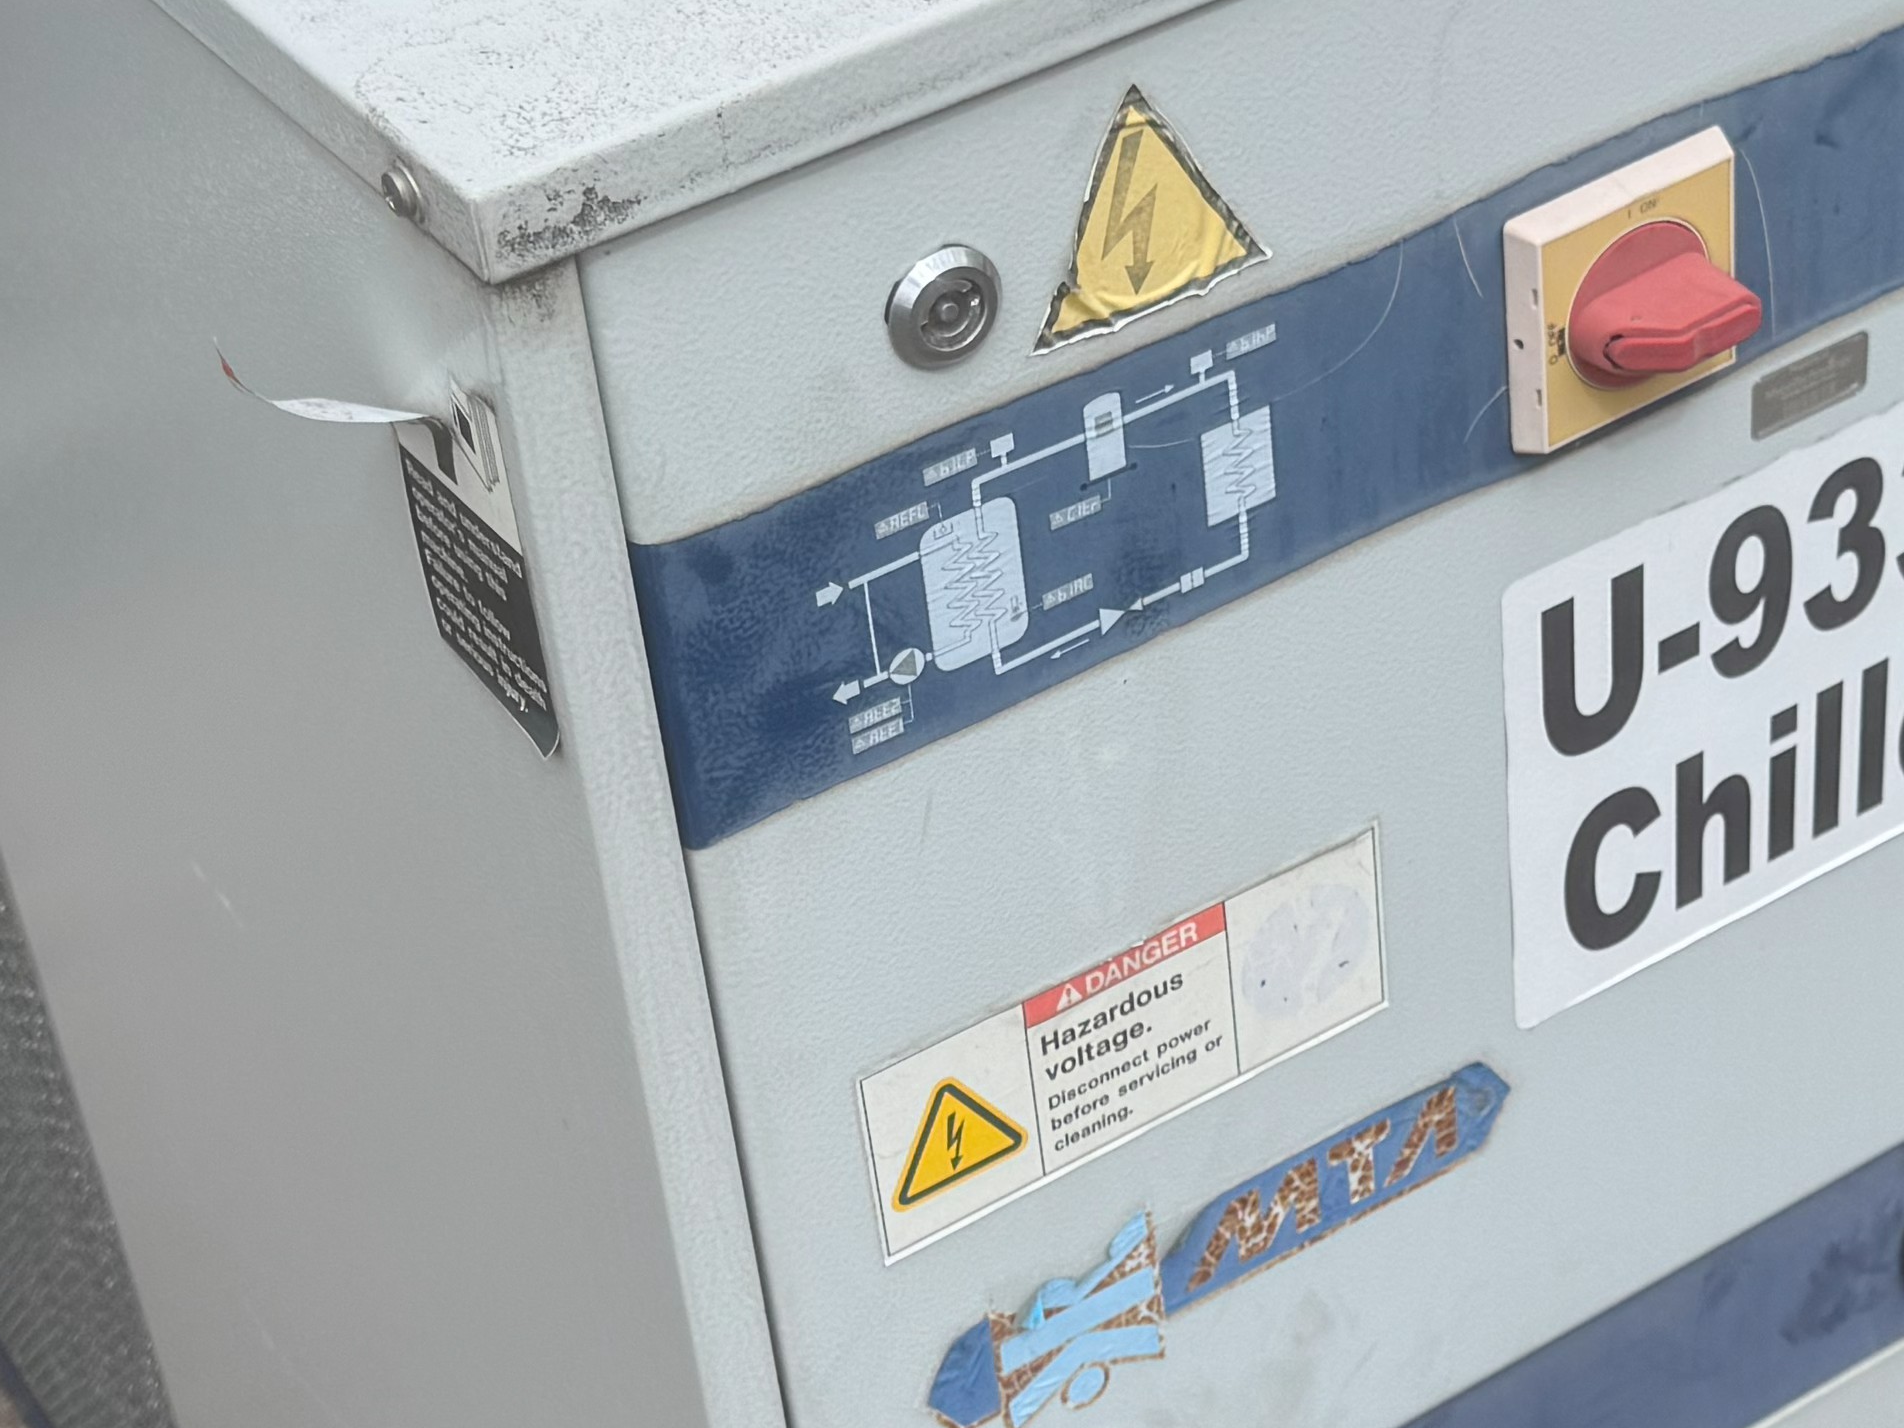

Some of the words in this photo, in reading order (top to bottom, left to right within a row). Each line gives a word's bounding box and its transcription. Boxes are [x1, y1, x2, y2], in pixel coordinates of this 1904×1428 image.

[1640, 200, 1657, 213] ON
[1548, 323, 1558, 347] OFF
[405, 459, 434, 496] Read
[436, 491, 457, 518] and
[459, 513, 523, 579] understand
[412, 487, 465, 543] operator's
[467, 538, 508, 584] manual
[415, 503, 451, 548] before
[453, 543, 484, 583] using
[485, 571, 507, 601] this
[424, 548, 461, 593] Failure
[462, 585, 475, 607] to
[478, 599, 511, 641] follow
[431, 575, 481, 632] operating
[482, 620, 547, 693] instructions
[436, 597, 465, 632] could
[467, 626, 499, 664] result
[500, 654, 512, 677] in
[514, 672, 547, 711] death
[441, 618, 452, 635] or
[456, 632, 494, 676] serious
[496, 668, 529, 713] injury.
[1084, 920, 1198, 994] DANGER
[1040, 973, 1184, 1057] Hazardous
[1045, 1021, 1153, 1082] voltage.
[1048, 1050, 1150, 1111] Disconnect
[1157, 1020, 1212, 1059] power
[1051, 1093, 1110, 1132] before
[1118, 1048, 1198, 1098] servicing
[1205, 1035, 1223, 1052] or
[1054, 1106, 1134, 1153] cleaning.
[1186, 1084, 1458, 1292] MTA
